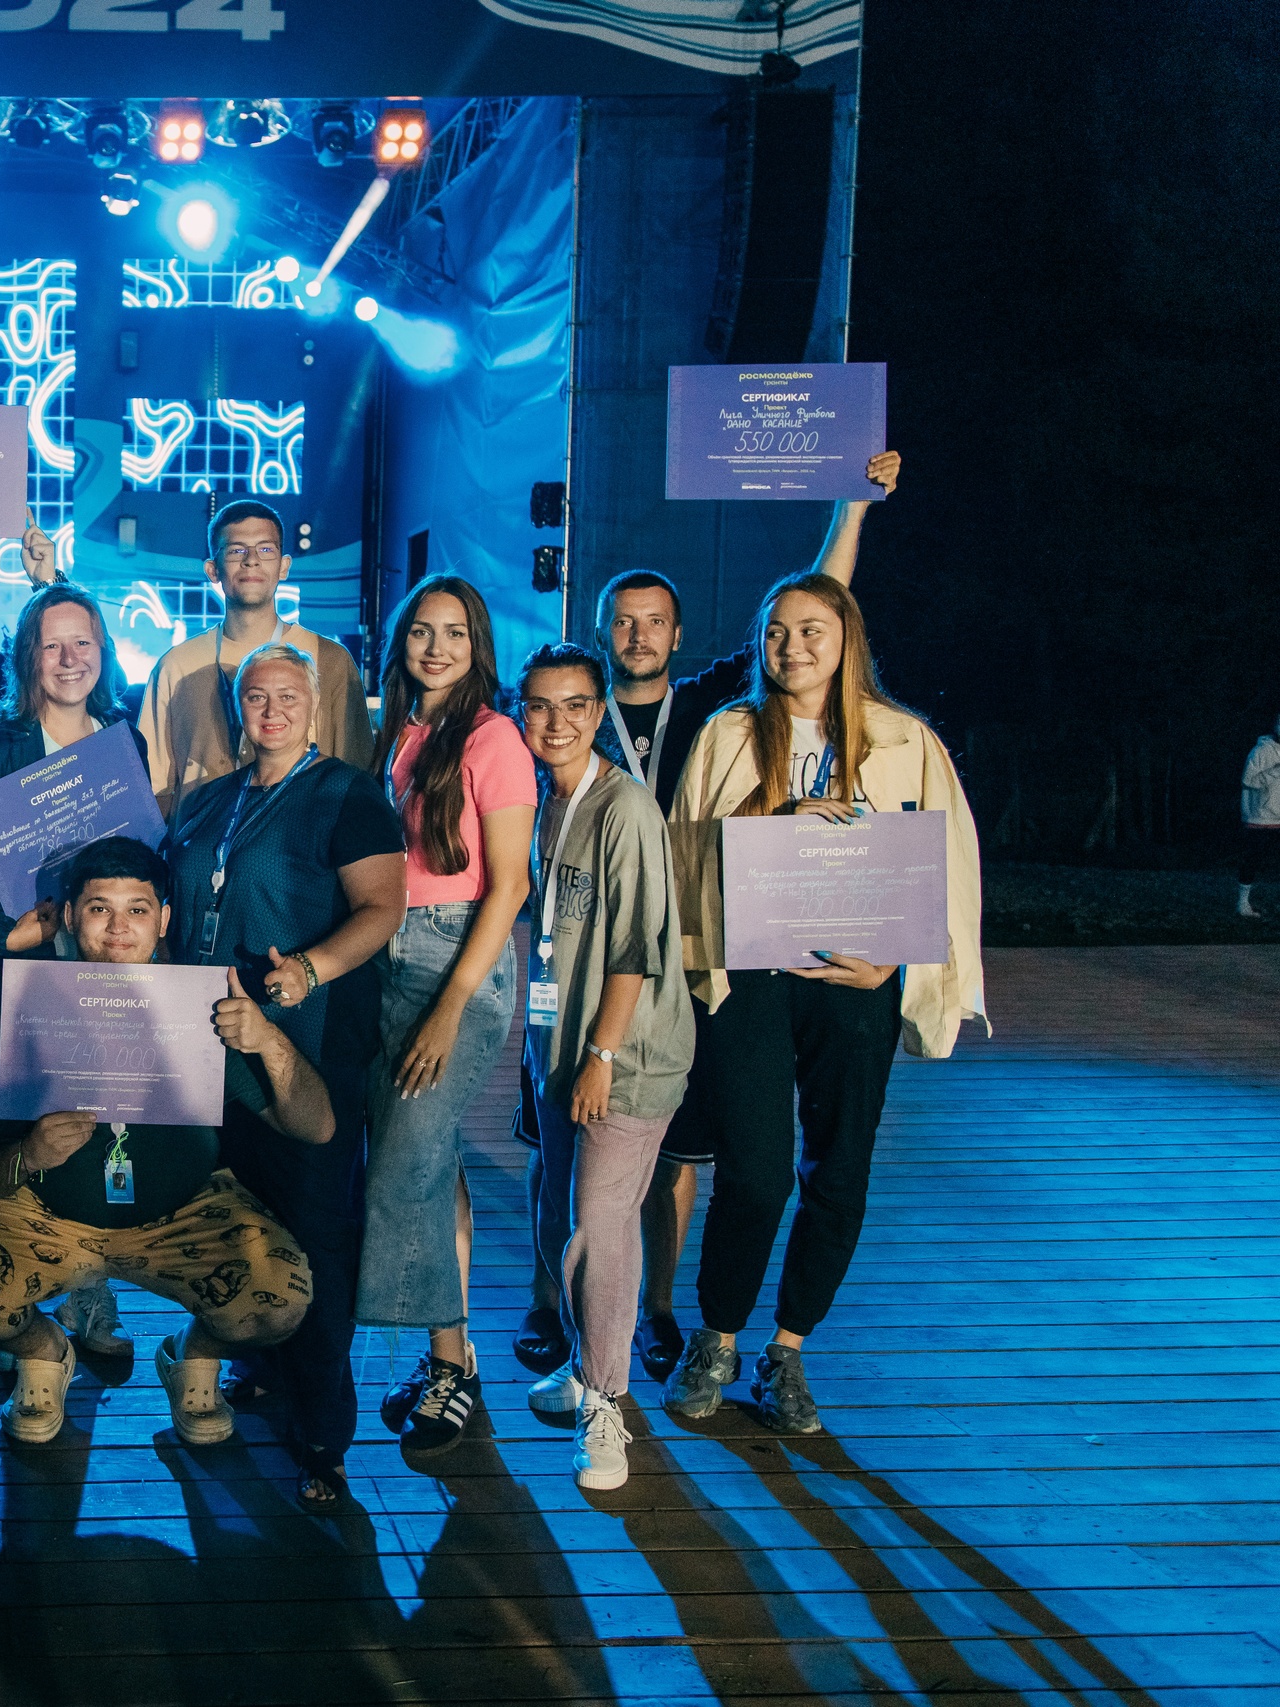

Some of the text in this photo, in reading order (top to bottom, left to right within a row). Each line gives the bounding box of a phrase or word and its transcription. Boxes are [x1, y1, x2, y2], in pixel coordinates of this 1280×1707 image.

[741, 393, 811, 402] СЕРТИФИКАТ
[719, 406, 836, 420] Лига Уличного Футбола
[734, 431, 819, 452] 550 000
[30, 774, 84, 806] СЕРТИФИКАТ
[37, 836, 64, 862] 186
[69, 822, 94, 845] 700
[799, 846, 870, 858] СЕРТИФИКАТ
[796, 896, 880, 918] 700 000
[79, 997, 151, 1009] СЕРТИФИКАТ
[61, 1042, 156, 1070] 140 000
